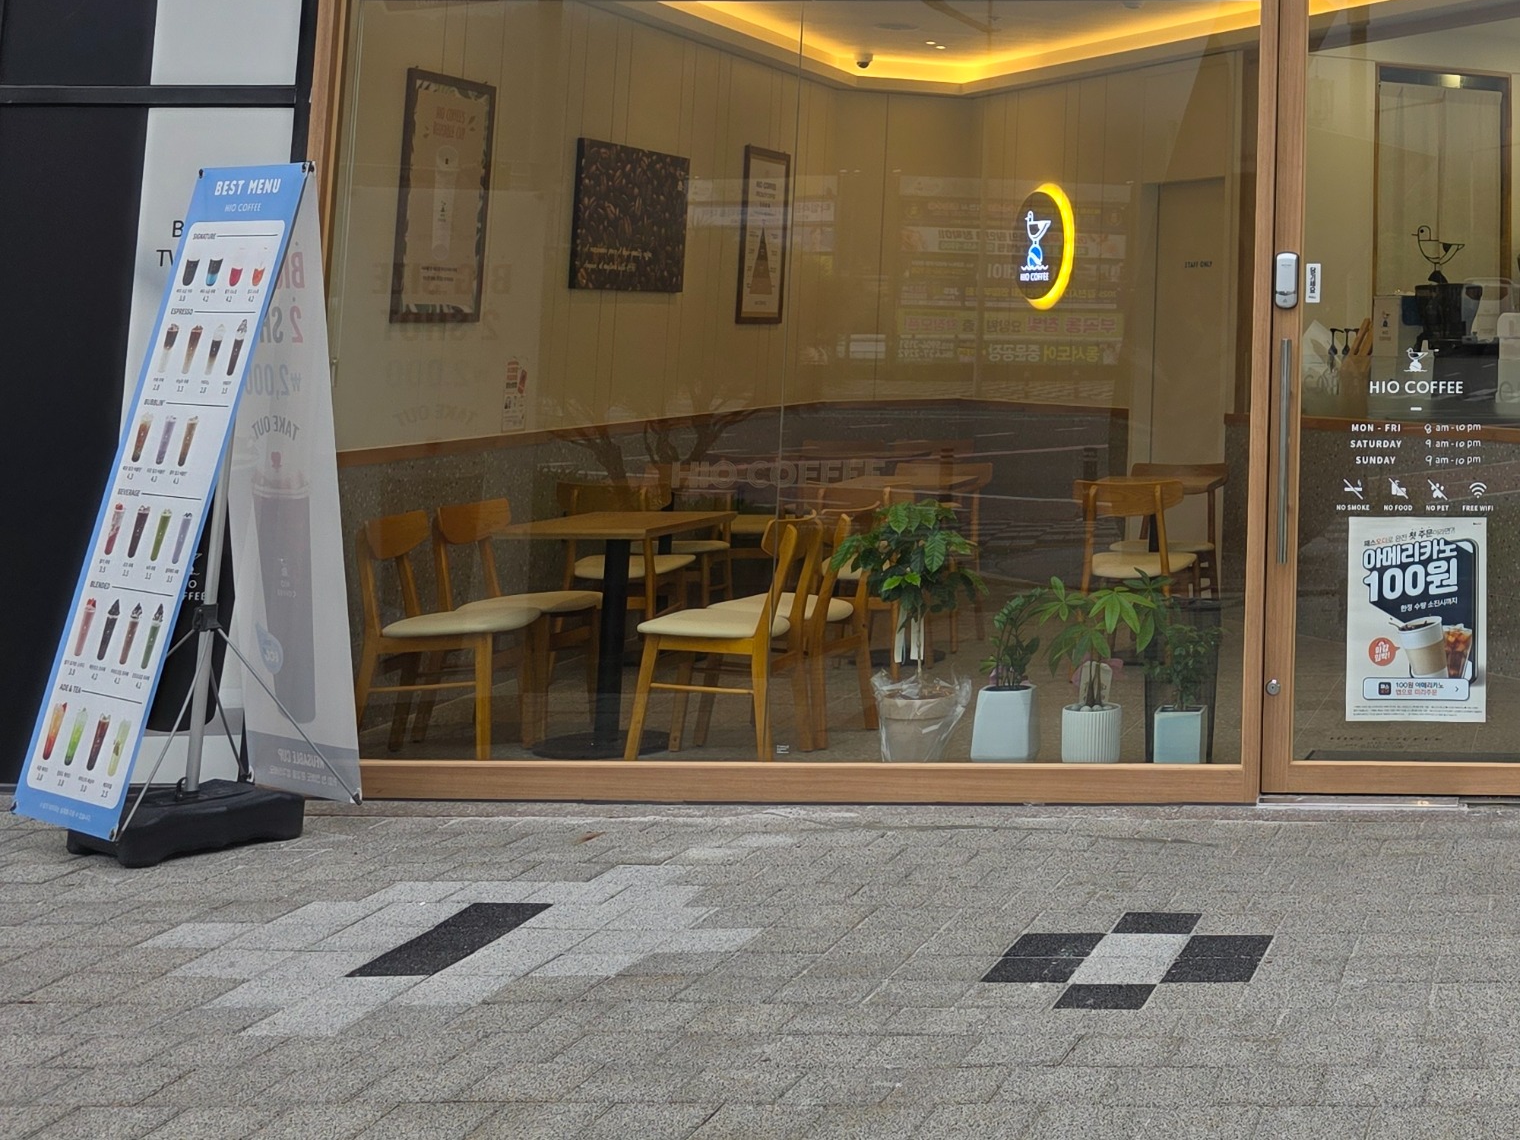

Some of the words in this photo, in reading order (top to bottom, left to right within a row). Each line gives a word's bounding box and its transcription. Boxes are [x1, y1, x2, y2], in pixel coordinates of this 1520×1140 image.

[214, 179, 243, 196] BEST
[247, 178, 282, 195] MENU
[237, 203, 262, 212] COFFEE
[1369, 380, 1400, 394] HIO
[1404, 380, 1464, 394] COFFEE
[1351, 423, 1374, 432] MON
[1384, 423, 1401, 432] FRI
[1350, 439, 1402, 448] SATURDAY
[1355, 456, 1396, 464] SUNDAY
[1363, 537, 1458, 569] 아메리카노
[1363, 557, 1459, 603] 100원
